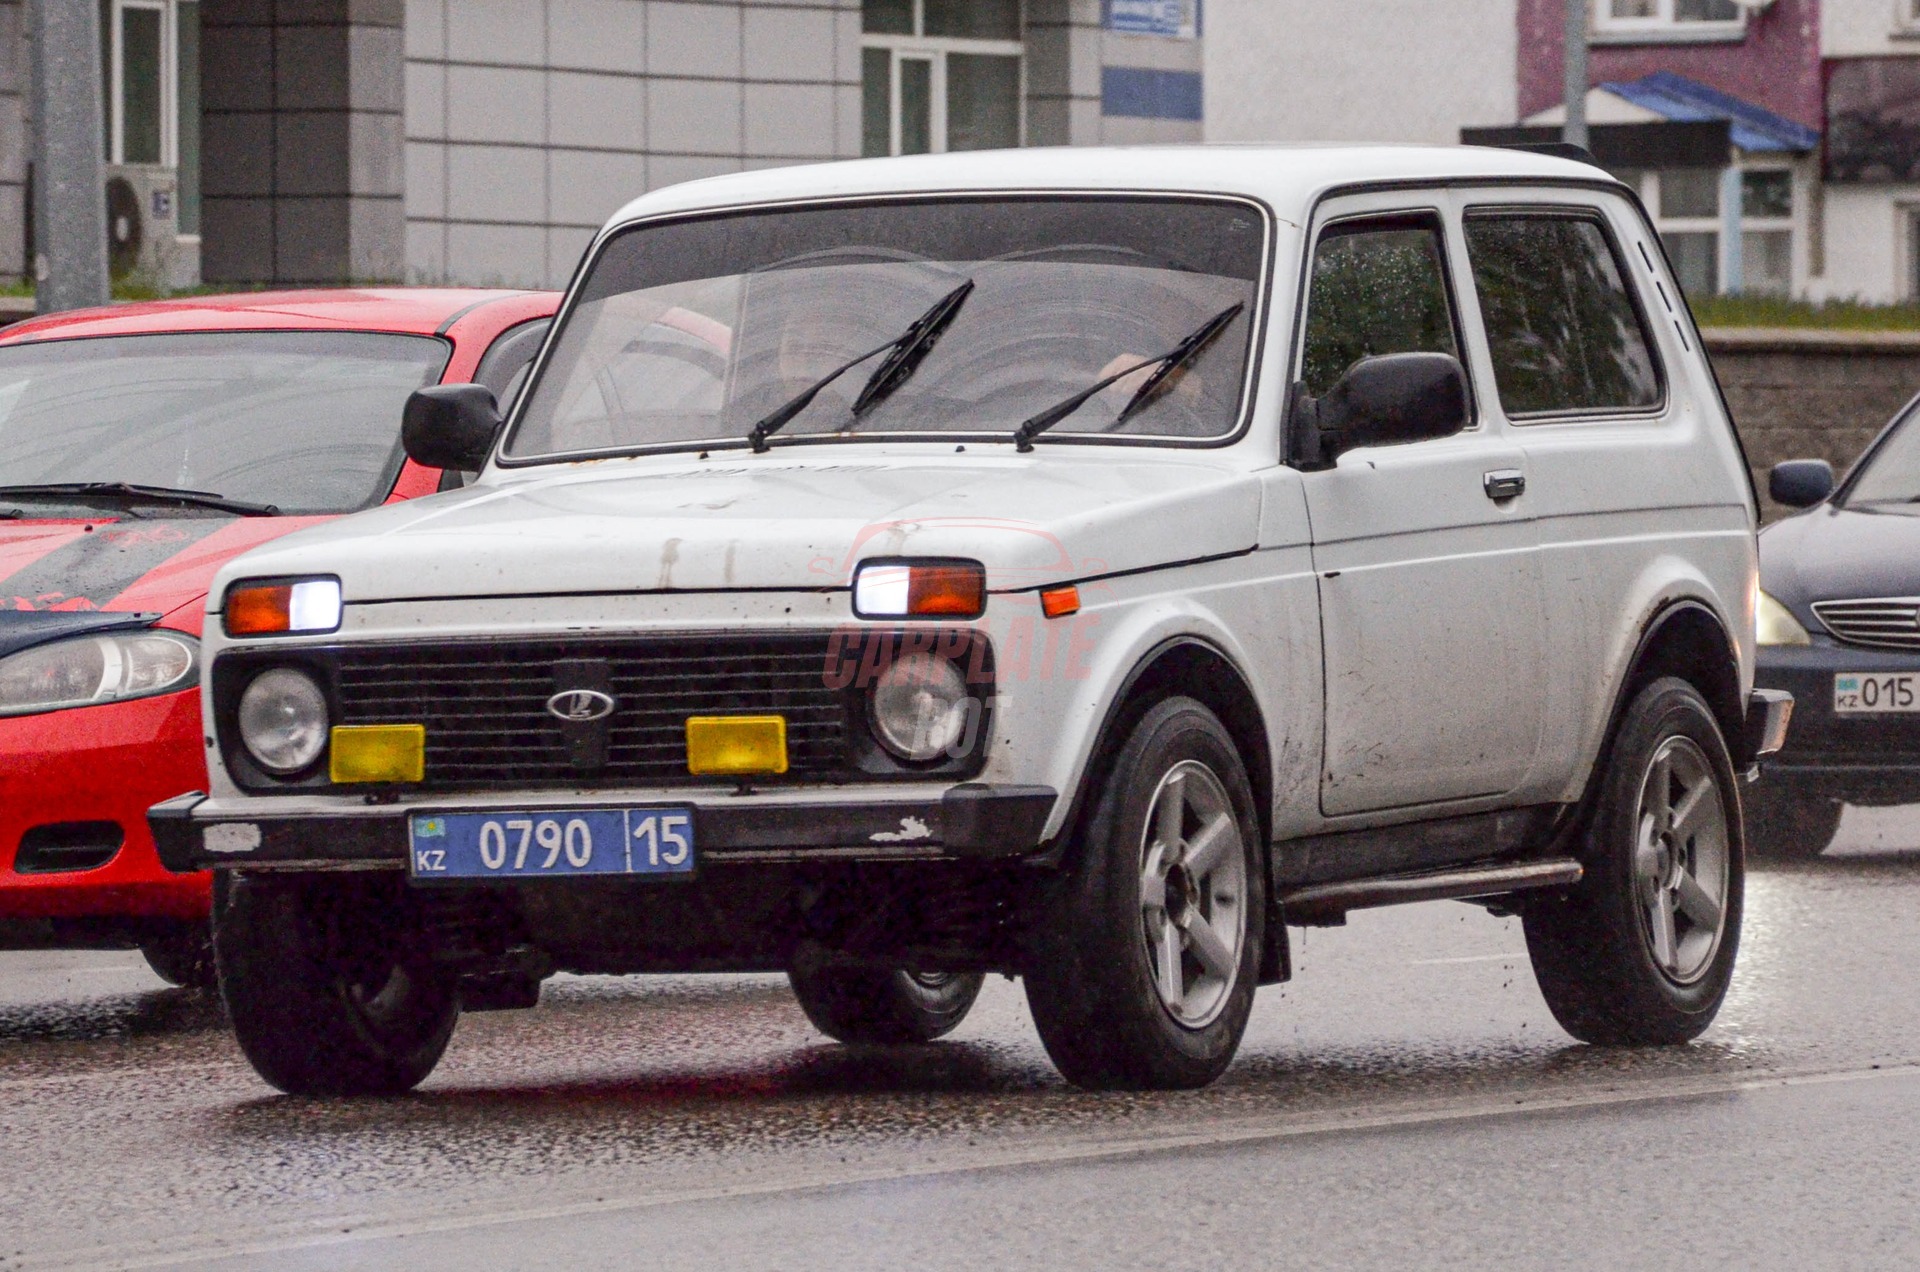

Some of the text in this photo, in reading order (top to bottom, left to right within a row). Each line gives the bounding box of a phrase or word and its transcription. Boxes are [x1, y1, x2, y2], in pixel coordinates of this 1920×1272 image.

[1837, 694, 1858, 708] KZ
[1862, 677, 1914, 707] 015
[479, 815, 689, 870] 0790 15
[416, 849, 447, 872] KZ
